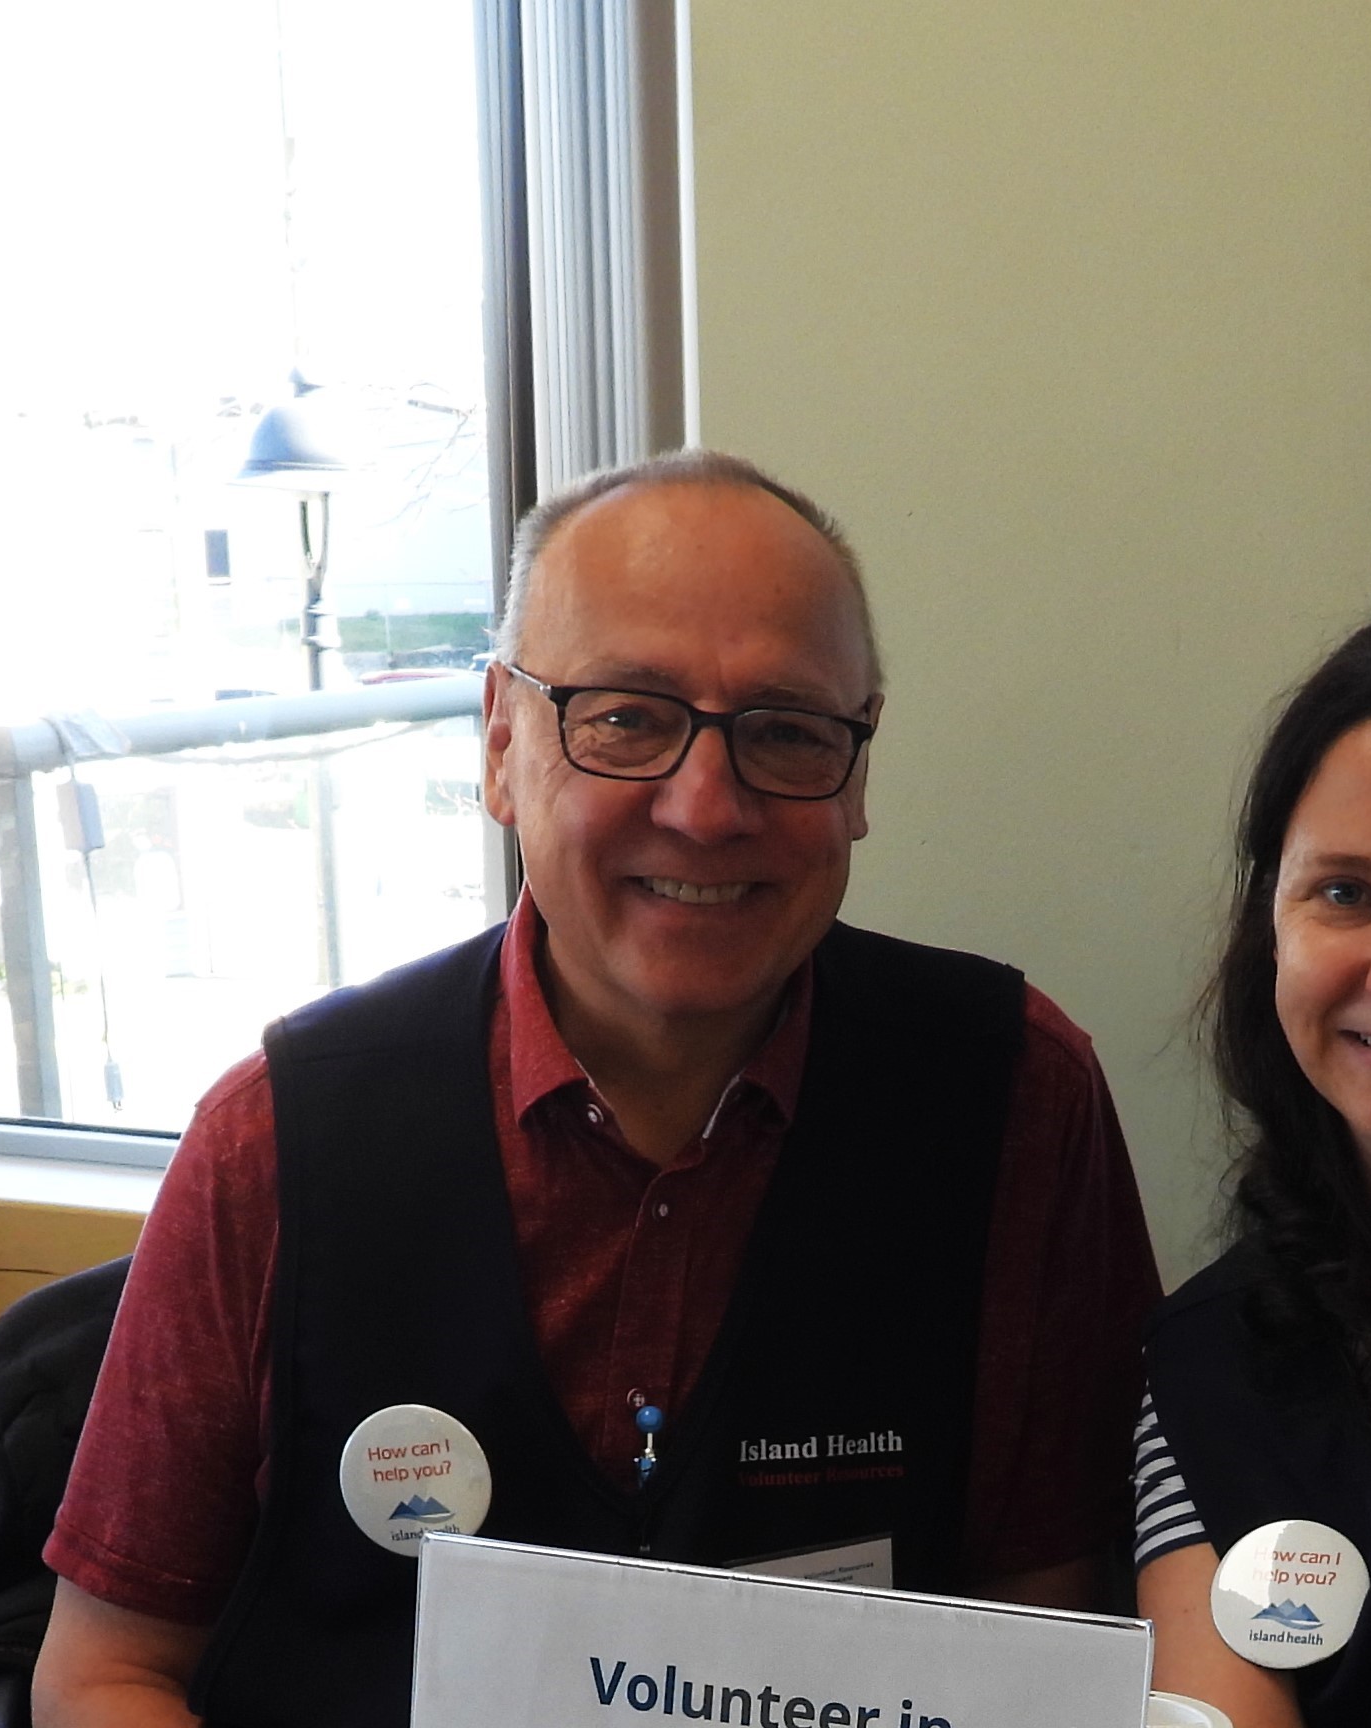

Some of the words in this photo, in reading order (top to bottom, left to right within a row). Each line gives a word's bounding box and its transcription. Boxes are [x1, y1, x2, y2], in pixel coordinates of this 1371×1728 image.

[367, 1447, 407, 1461] How
[411, 1442, 441, 1457] can
[444, 1438, 450, 1452] I
[740, 1436, 818, 1462] Island
[827, 1430, 902, 1457] Health
[373, 1467, 409, 1482] help
[412, 1460, 451, 1480] you?
[1253, 1546, 1296, 1562] How
[1300, 1552, 1331, 1564] can
[1335, 1552, 1341, 1565] I
[1252, 1567, 1290, 1584] help
[1294, 1571, 1337, 1586] you?
[1249, 1629, 1285, 1643] island
[1286, 1631, 1323, 1645] health
